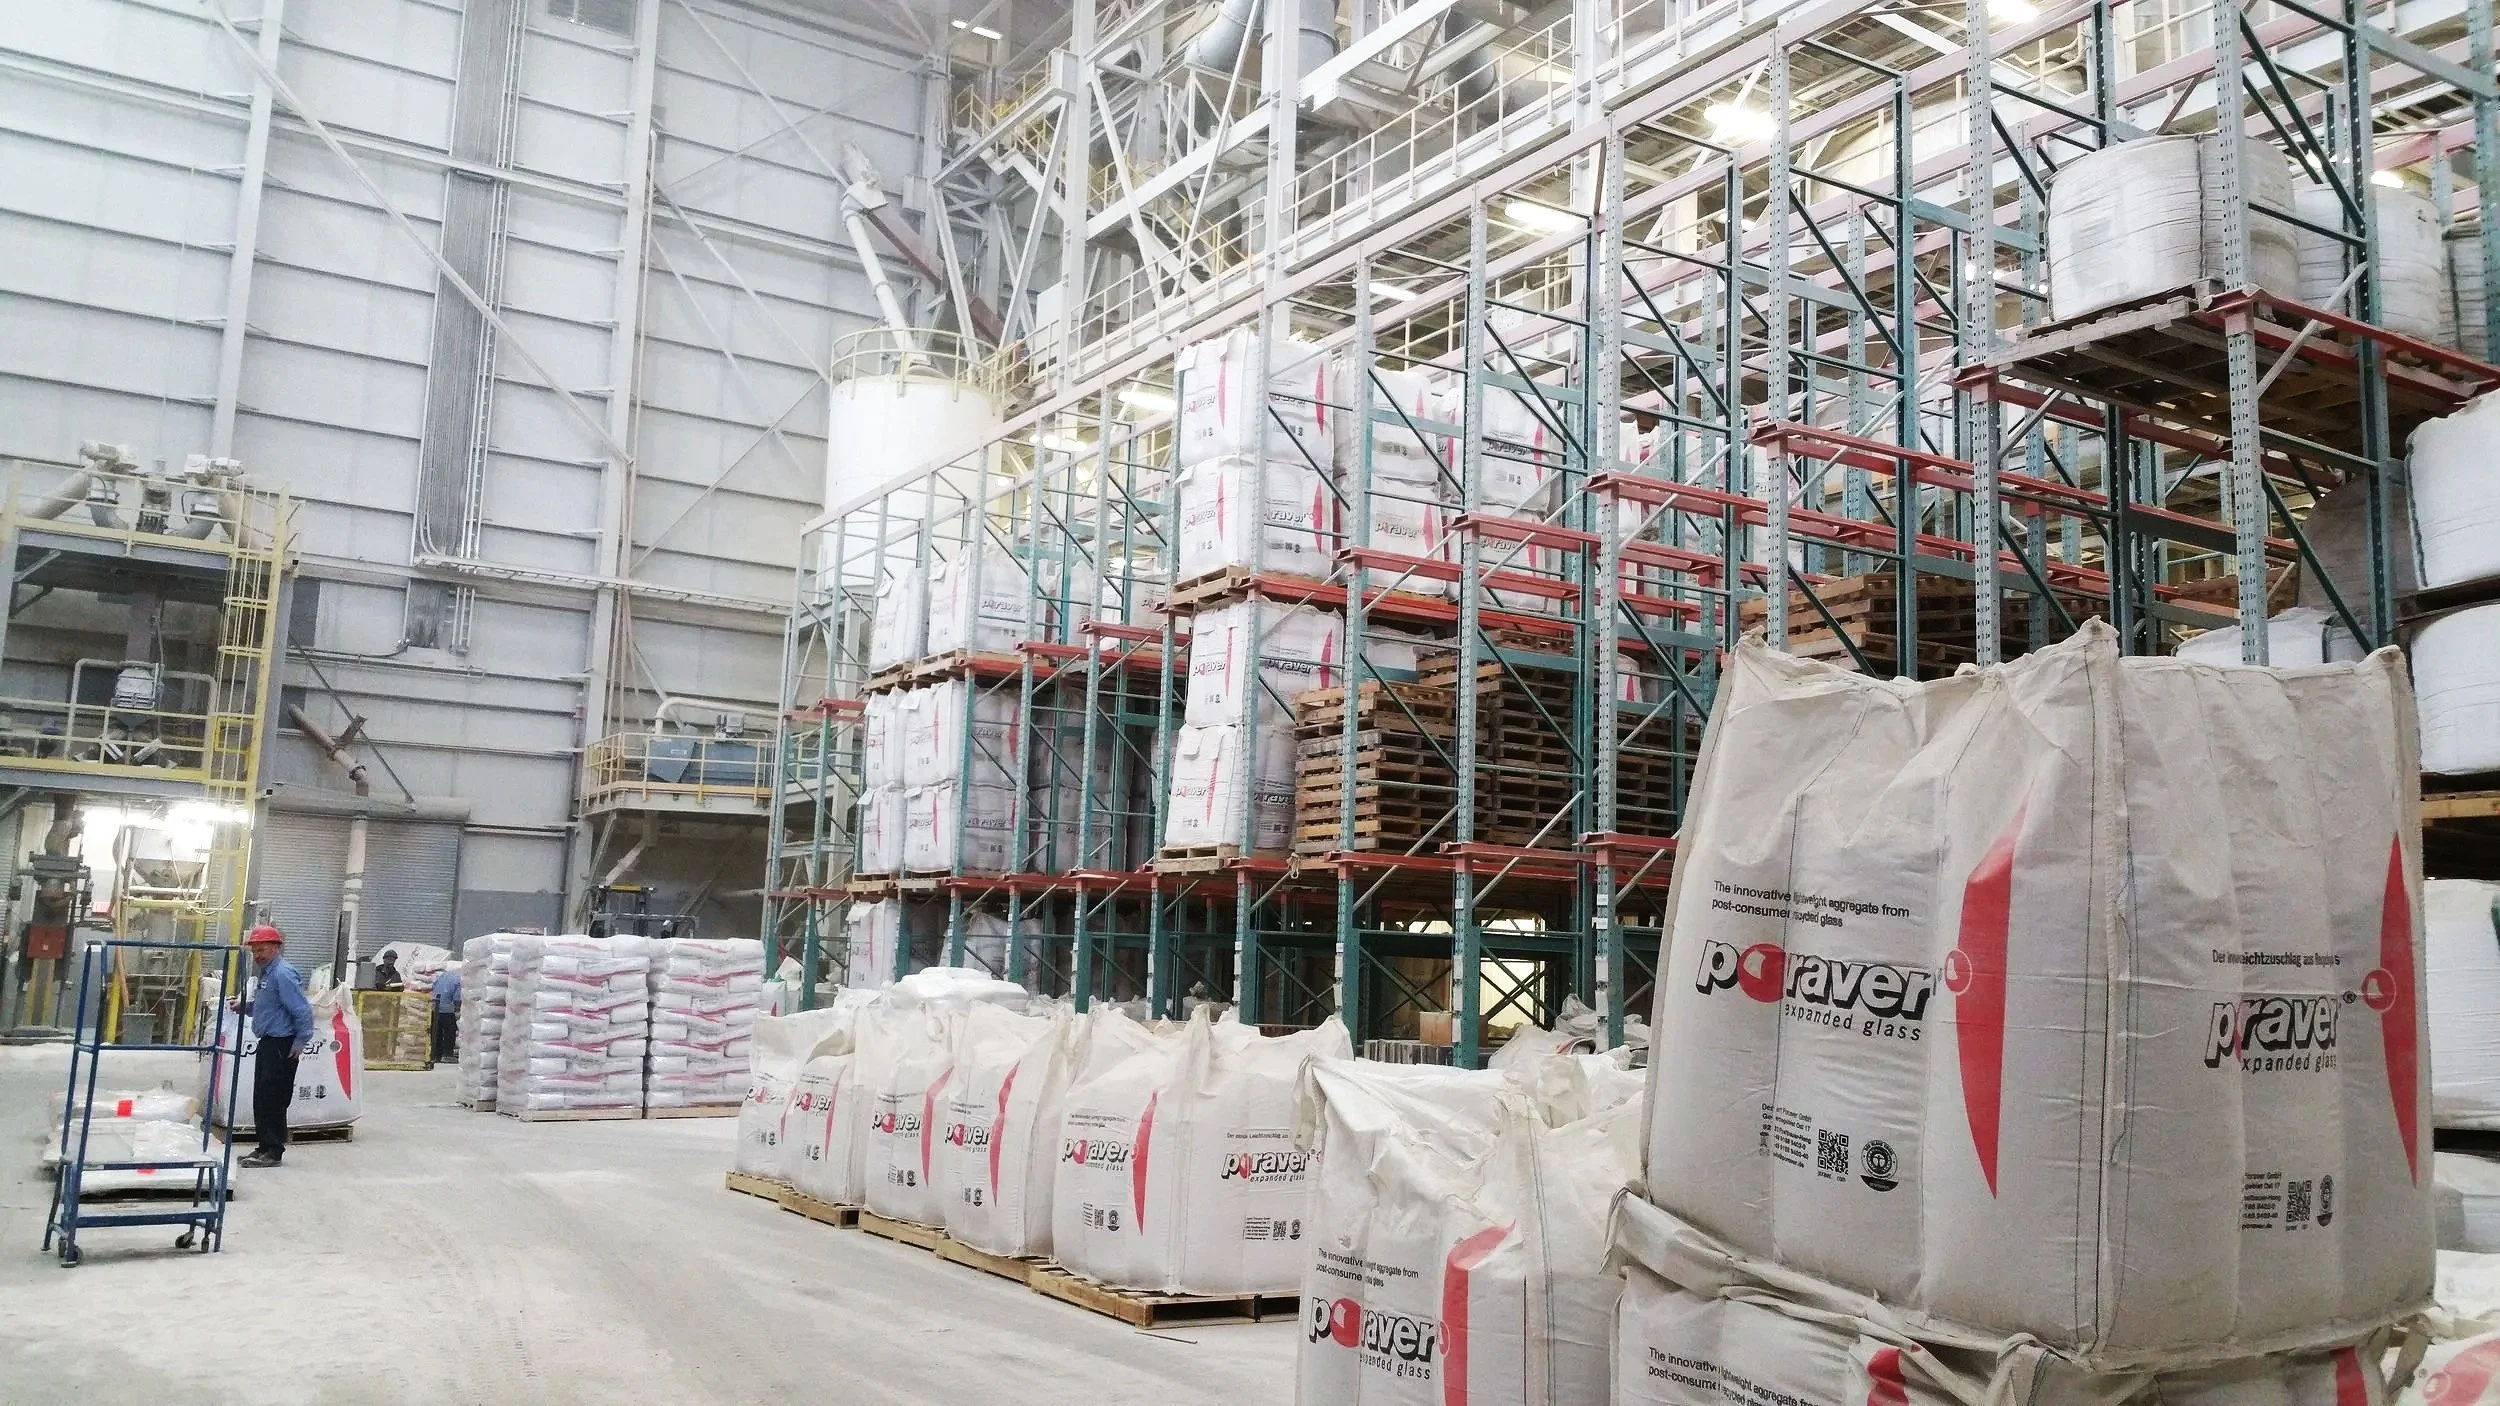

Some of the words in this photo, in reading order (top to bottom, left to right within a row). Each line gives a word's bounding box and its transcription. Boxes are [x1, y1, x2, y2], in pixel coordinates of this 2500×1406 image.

[1713, 880, 1731, 894] The
[1733, 884, 1791, 902] innovative
[1828, 898, 1879, 916] aggregate
[1882, 904, 1910, 918] from
[1820, 913, 1843, 928] glass
[2212, 949, 2226, 964] Der
[1695, 938, 1937, 1021] poraver
[1784, 1003, 1854, 1030] expanded
[1862, 1018, 1922, 1042] glass
[2204, 995, 2342, 1069] praver
[2241, 1053, 2311, 1075] xpanded
[1220, 1151, 1309, 1180] poraver
[1315, 1263, 1363, 1282] post-consume
[1402, 1266, 1419, 1279] from
[1308, 1296, 1436, 1364] poraver
[1396, 1362, 1431, 1381] glass
[1648, 1346, 1666, 1363] The
[1753, 1384, 1799, 1406] aggregate
[1648, 1365, 1717, 1391] post-consume
